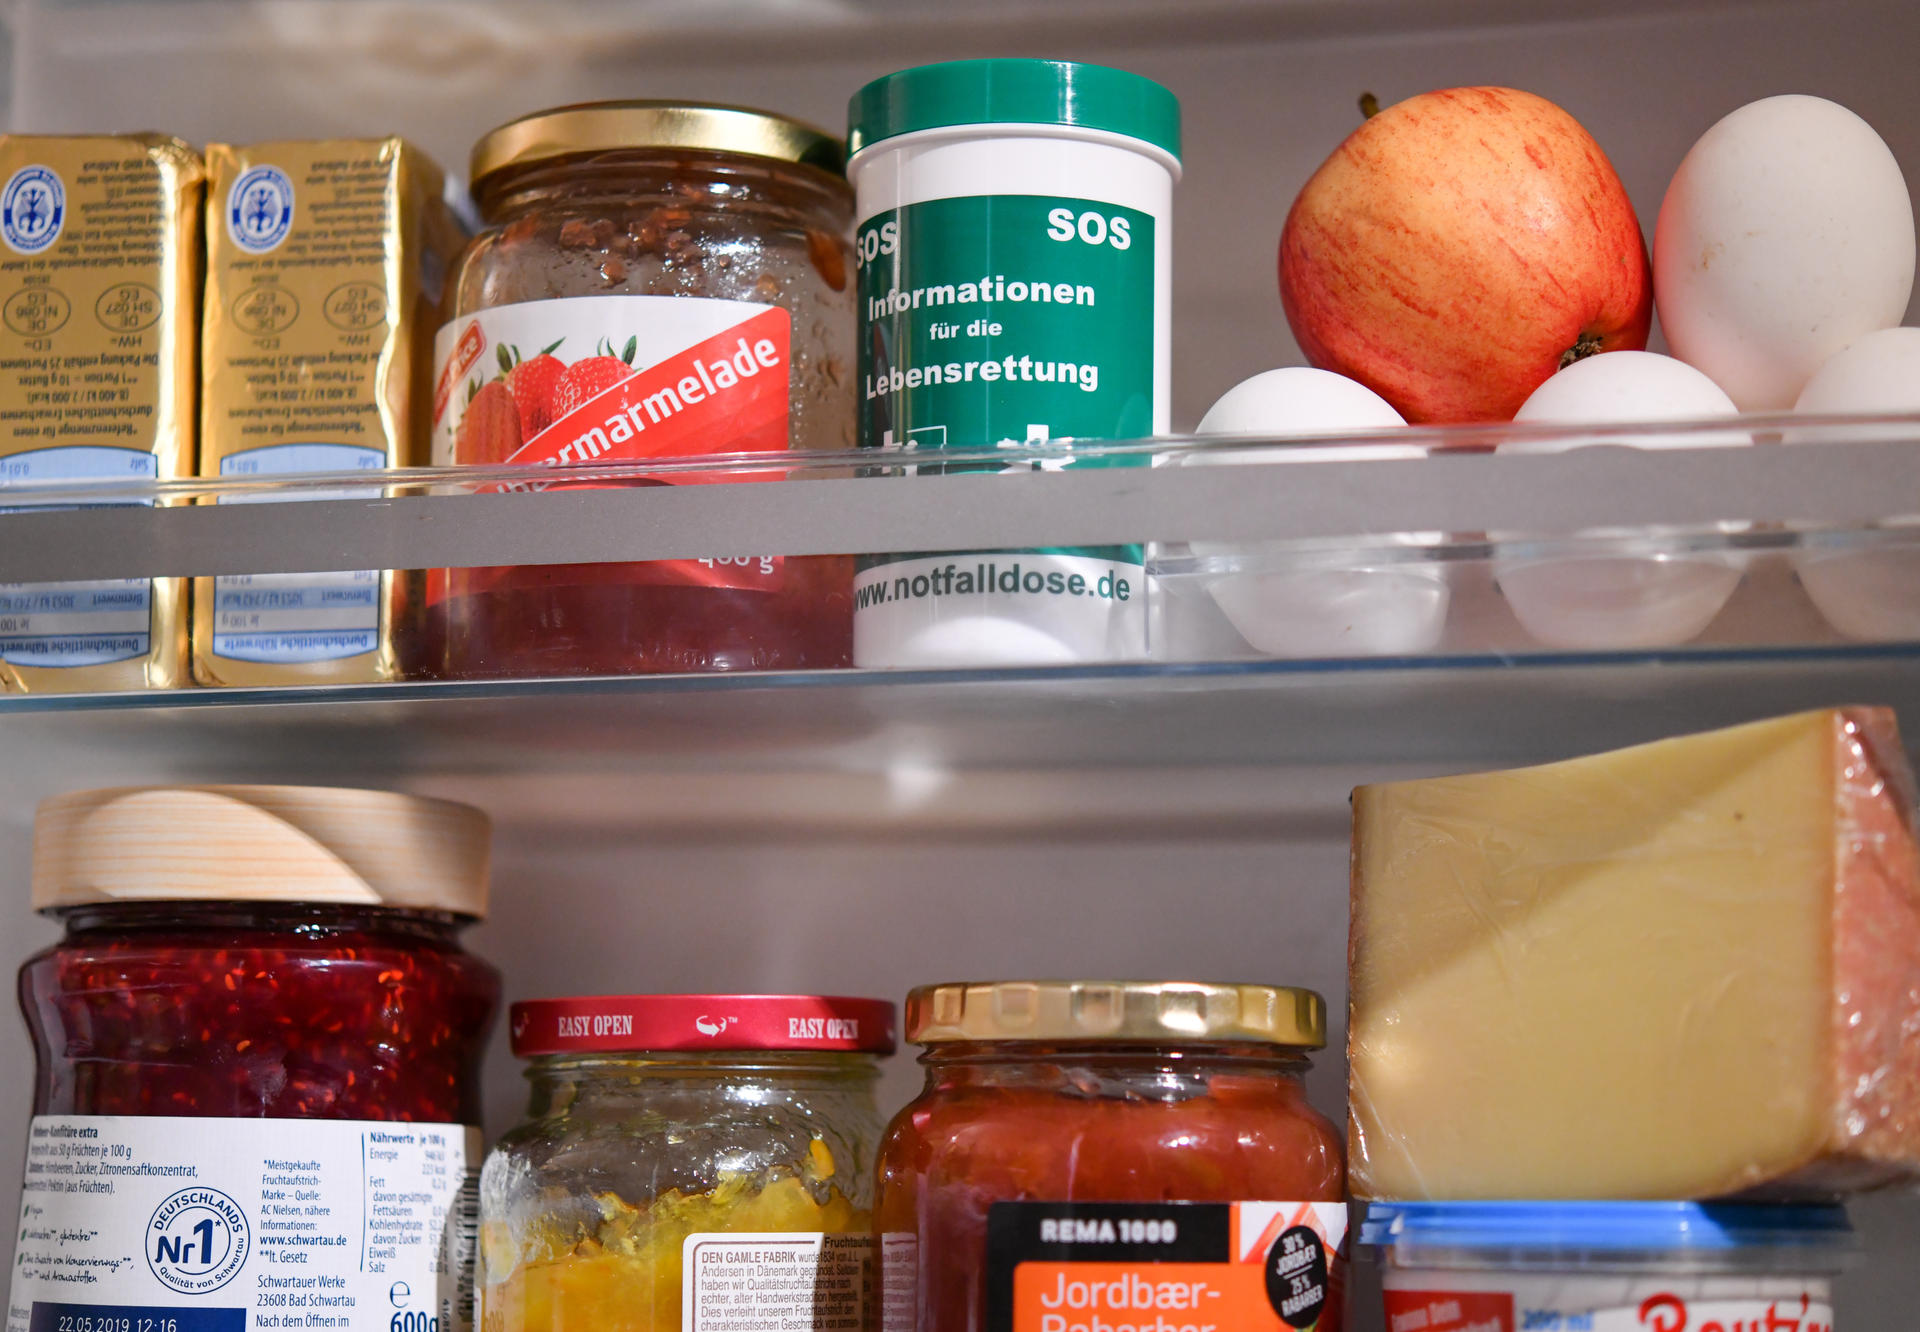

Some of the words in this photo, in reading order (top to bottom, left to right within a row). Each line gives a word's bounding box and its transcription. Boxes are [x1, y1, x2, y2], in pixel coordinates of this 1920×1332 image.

[1047, 208, 1131, 249] SOS
[868, 275, 1095, 321] Informationen
[930, 323, 959, 340] für
[967, 319, 1003, 337] die
[100, 353, 140, 366] Packung
[867, 355, 1099, 400] Lebensrettung
[0, 641, 48, 655] Nährwert
[52, 639, 138, 654] Durchschnittliche
[280, 635, 367, 650] Durchschnittliche
[558, 1016, 590, 1037] EASY
[594, 1015, 632, 1036] OPEN
[789, 1018, 823, 1038] EASY
[827, 1019, 858, 1039] OPEN
[80, 1127, 98, 1138] extra
[370, 1132, 414, 1144] Nährwerte
[72, 1143, 100, 1157] Früchten
[101, 1145, 108, 1159] je
[111, 1144, 124, 1157] 100
[126, 1147, 132, 1160] g
[370, 1148, 398, 1163] Energie
[76, 1162, 98, 1176] Zucker,
[99, 1163, 198, 1178] Zitronensaftkonzentrat,
[65, 1180, 78, 1194] (aus
[80, 1179, 115, 1194] Früchten).
[262, 1174, 322, 1186] Fruchtaufstrich-
[370, 1176, 385, 1188] Fett
[262, 1190, 286, 1200] Marke
[295, 1190, 321, 1202] Quelle:
[373, 1191, 399, 1202] davon
[154, 1193, 243, 1233] DEUTSCHLANDS
[261, 1205, 272, 1216] AC
[273, 1205, 301, 1218] Nielsen,
[305, 1206, 330, 1216] nähere
[373, 1204, 413, 1216] Fettsäuren
[260, 1220, 317, 1230] Informationen:
[370, 1219, 422, 1232] Kohlenhydrate
[1041, 1219, 1115, 1243] REMA
[1119, 1219, 1177, 1243] 1000
[260, 1234, 347, 1246] www.schwartau.de
[373, 1232, 397, 1244] davon
[398, 1233, 422, 1244] Zucker
[280, 1251, 308, 1264] Gesetz
[369, 1247, 396, 1259] Eiweiß
[702, 1252, 722, 1263] DEN
[726, 1252, 760, 1263] GAMLE
[764, 1251, 796, 1262] FABRIK
[160, 1266, 194, 1288] Qualität
[197, 1279, 214, 1289] von
[215, 1237, 244, 1282] Schwartau
[369, 1261, 386, 1272] Salz
[702, 1265, 745, 1277] Andersen
[747, 1265, 754, 1276] in
[757, 1264, 798, 1276] Dänemark
[258, 1275, 316, 1288] Schwartauer
[318, 1275, 346, 1288] Werke
[702, 1279, 730, 1290] haben
[732, 1279, 744, 1290] wir
[1041, 1272, 1221, 1309] Jordbær-
[257, 1294, 286, 1307] 23608
[289, 1294, 306, 1307] Bad
[309, 1294, 356, 1308] Schwartau
[702, 1293, 731, 1305] echter,
[734, 1293, 752, 1304] alter
[756, 1291, 826, 1304] Handwerkstradition
[702, 1306, 722, 1317] Dies
[724, 1306, 756, 1317] verleiht
[758, 1306, 793, 1316] unserem
[59, 1316, 130, 1332] 22.05.2019
[256, 1314, 280, 1328] Nach
[282, 1314, 302, 1328] dem
[305, 1313, 335, 1328] Öffnen
[338, 1315, 350, 1328] im
[701, 1320, 779, 1332] charakteristischen
[782, 1318, 824, 1330] Geschmack
